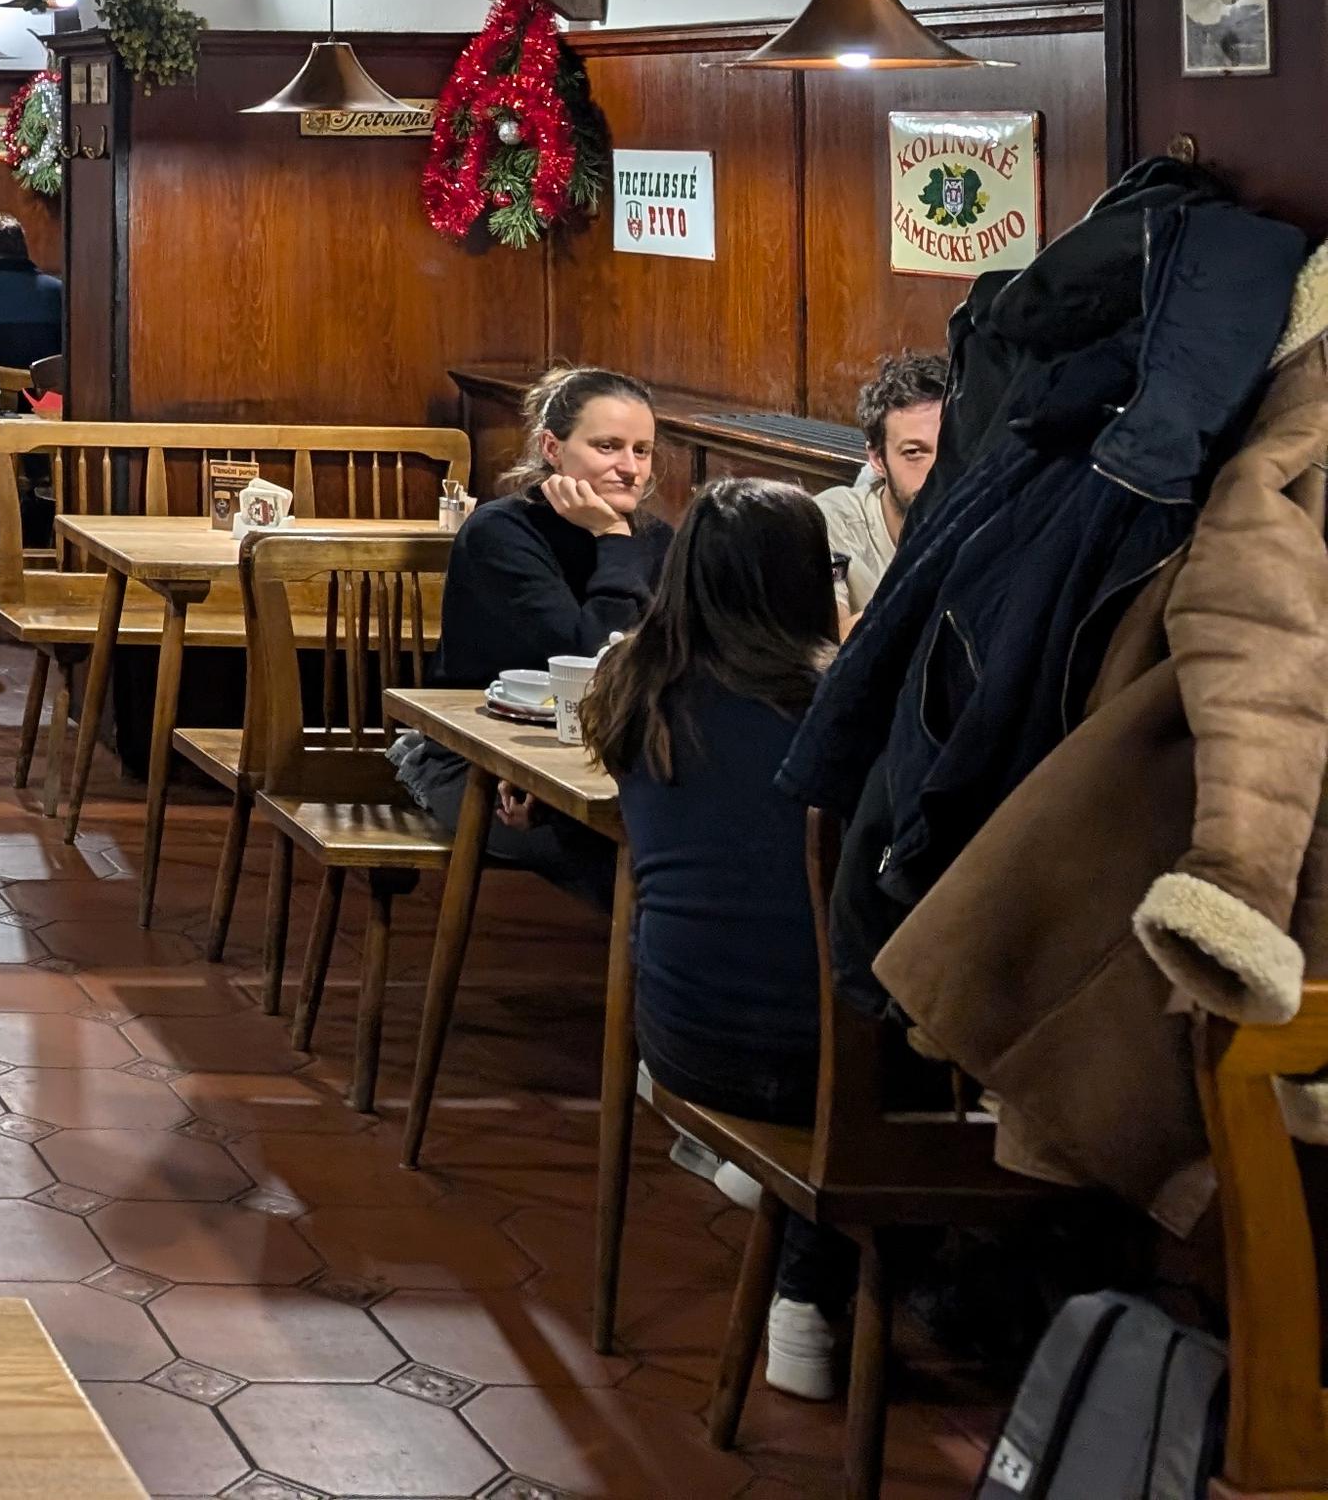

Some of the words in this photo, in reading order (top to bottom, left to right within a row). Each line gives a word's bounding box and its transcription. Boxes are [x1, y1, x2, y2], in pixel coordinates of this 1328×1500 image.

[618, 165, 697, 199] VRCHLABSKÉ
[648, 206, 687, 238] PIVO
[893, 201, 977, 262] ZÁMECKÉ
[976, 210, 1026, 259] PIVO
